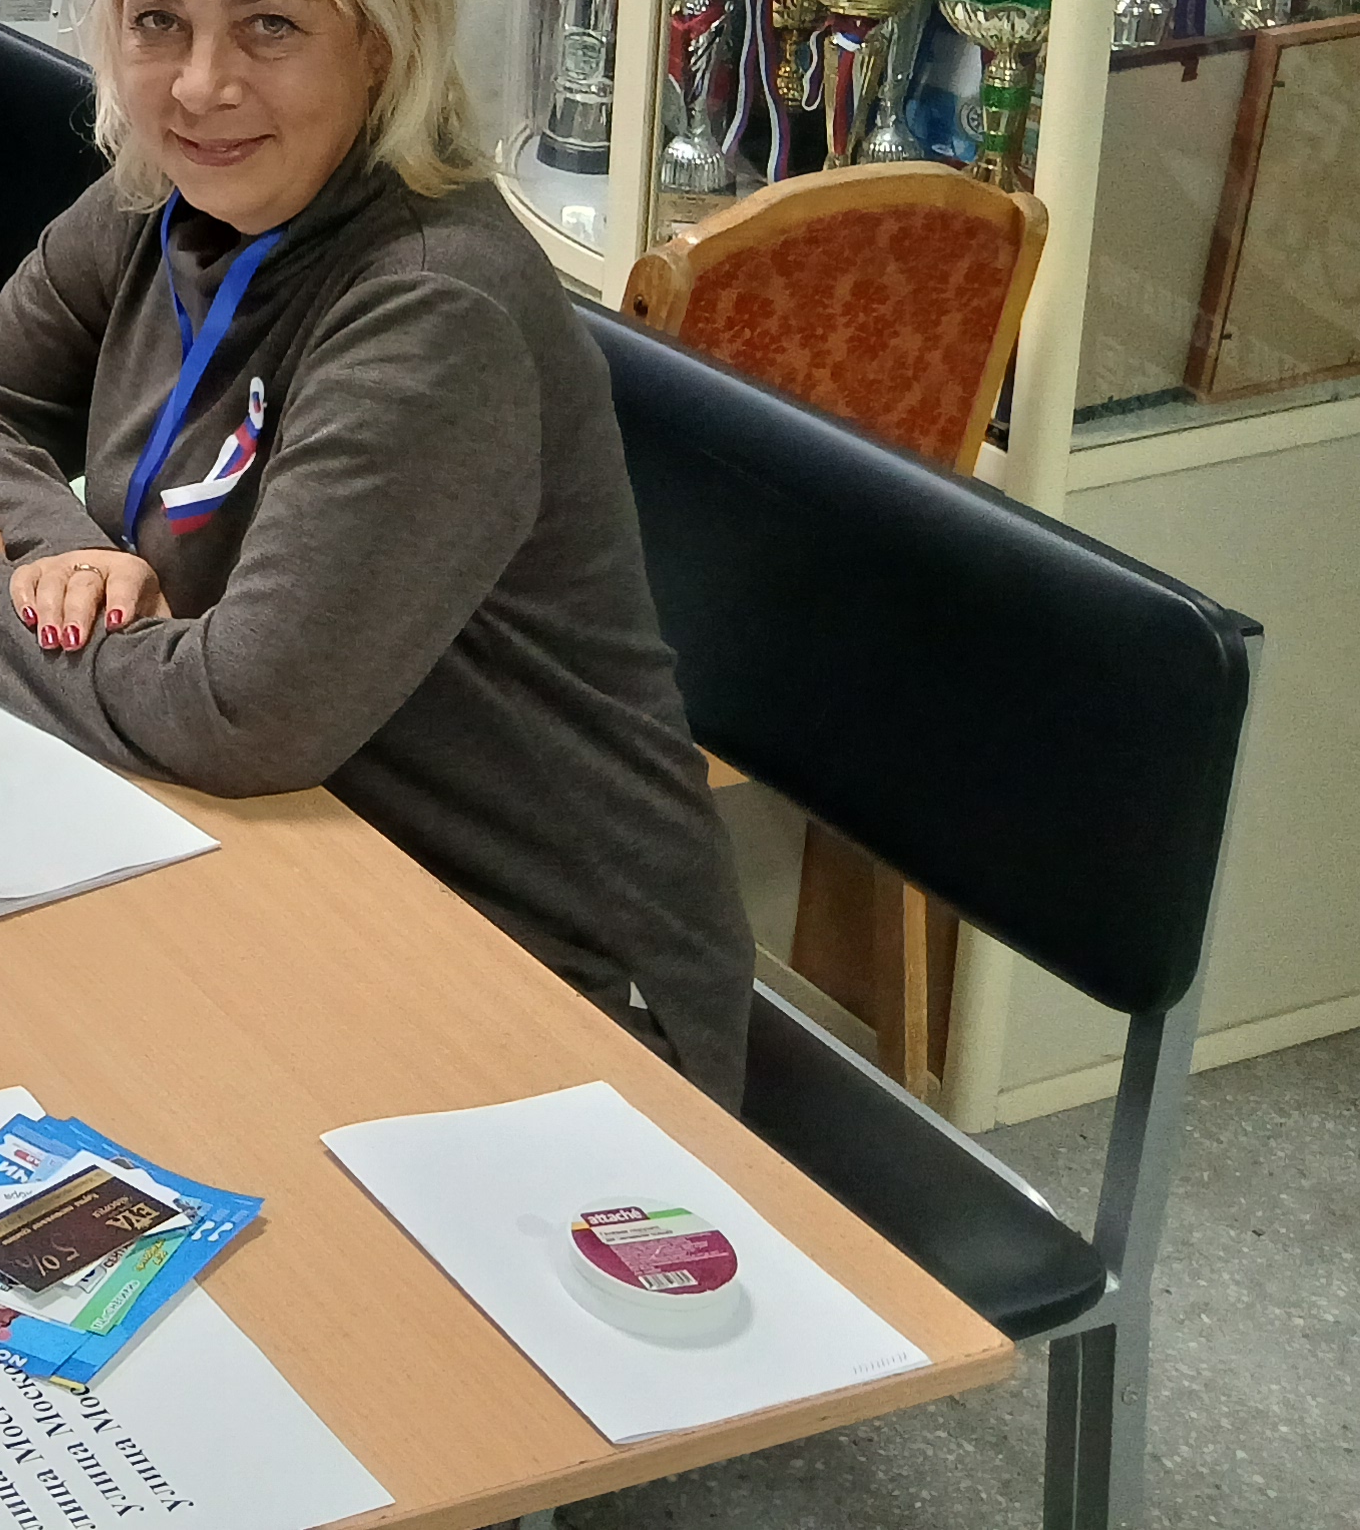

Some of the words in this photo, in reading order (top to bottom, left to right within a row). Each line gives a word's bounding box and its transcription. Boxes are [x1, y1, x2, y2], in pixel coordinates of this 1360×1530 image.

[587, 1208, 643, 1225] attaché
[3, 1363, 75, 1440] Моско
[36, 1469, 97, 1530] лица
[66, 1441, 145, 1518] улица
[114, 1436, 195, 1513] улица
